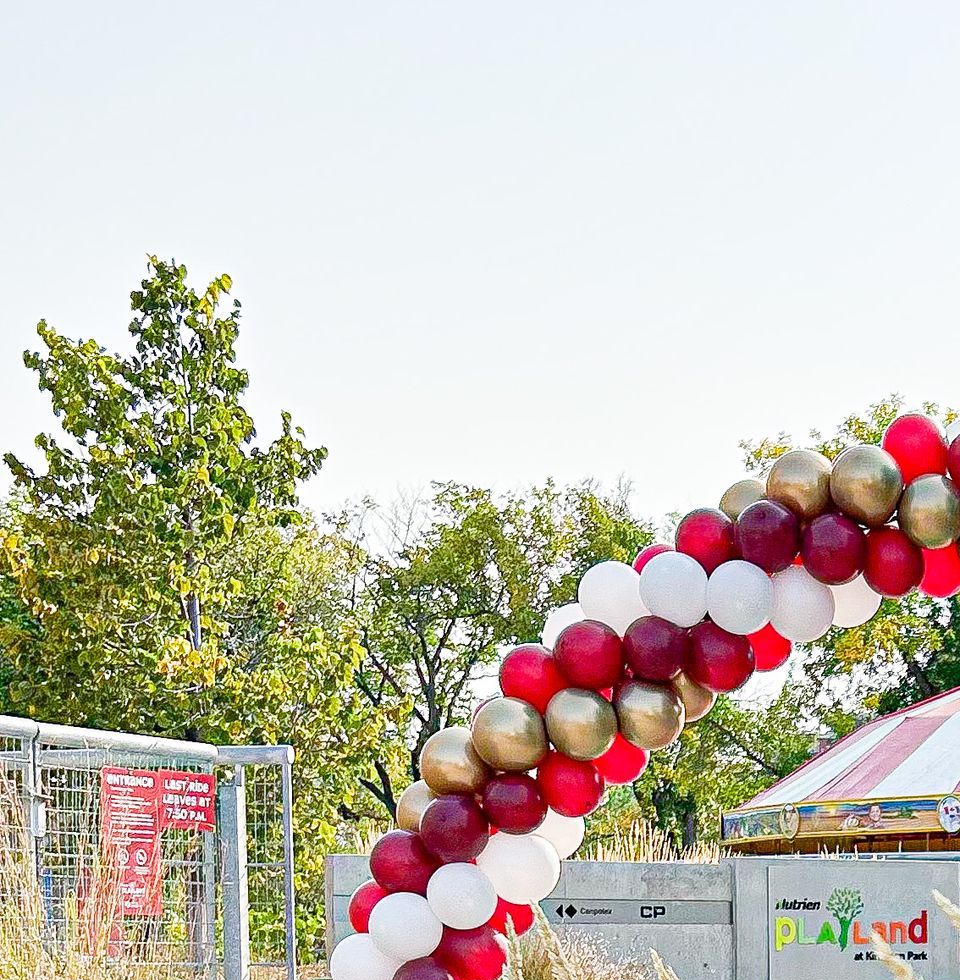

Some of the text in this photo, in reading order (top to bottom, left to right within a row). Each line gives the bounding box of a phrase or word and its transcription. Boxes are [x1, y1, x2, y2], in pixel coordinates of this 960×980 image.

[775, 898, 821, 910] Nutrien
[640, 905, 666, 919] CP
[853, 951, 864, 961] at
[907, 951, 928, 961] Park
